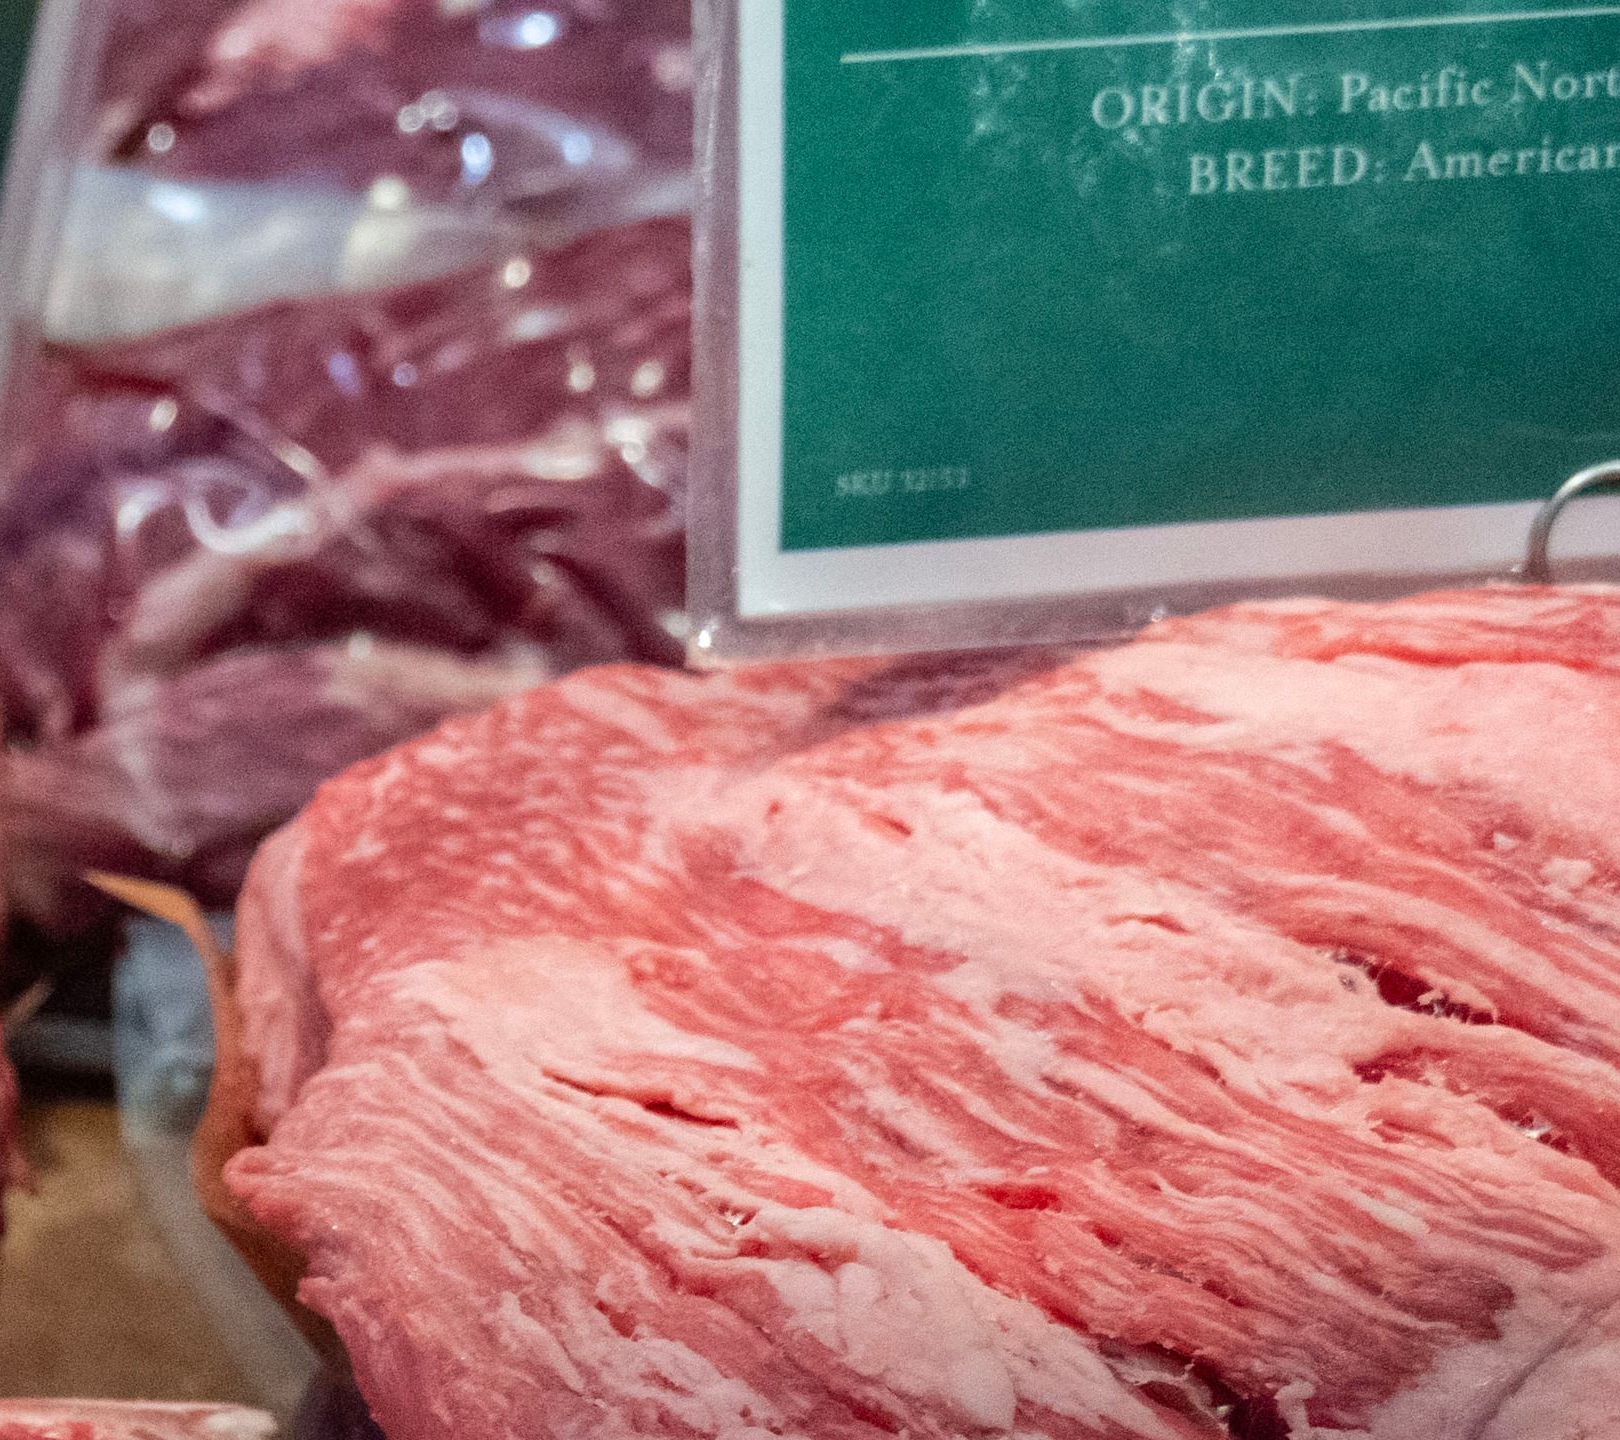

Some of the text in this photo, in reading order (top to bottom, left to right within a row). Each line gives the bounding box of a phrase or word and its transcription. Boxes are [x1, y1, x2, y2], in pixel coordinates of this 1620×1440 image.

[1090, 69, 1319, 129] ORIGIN:
[1340, 64, 1494, 113] Pacific
[1189, 144, 1387, 196] BREED:
[835, 469, 892, 498] SKU
